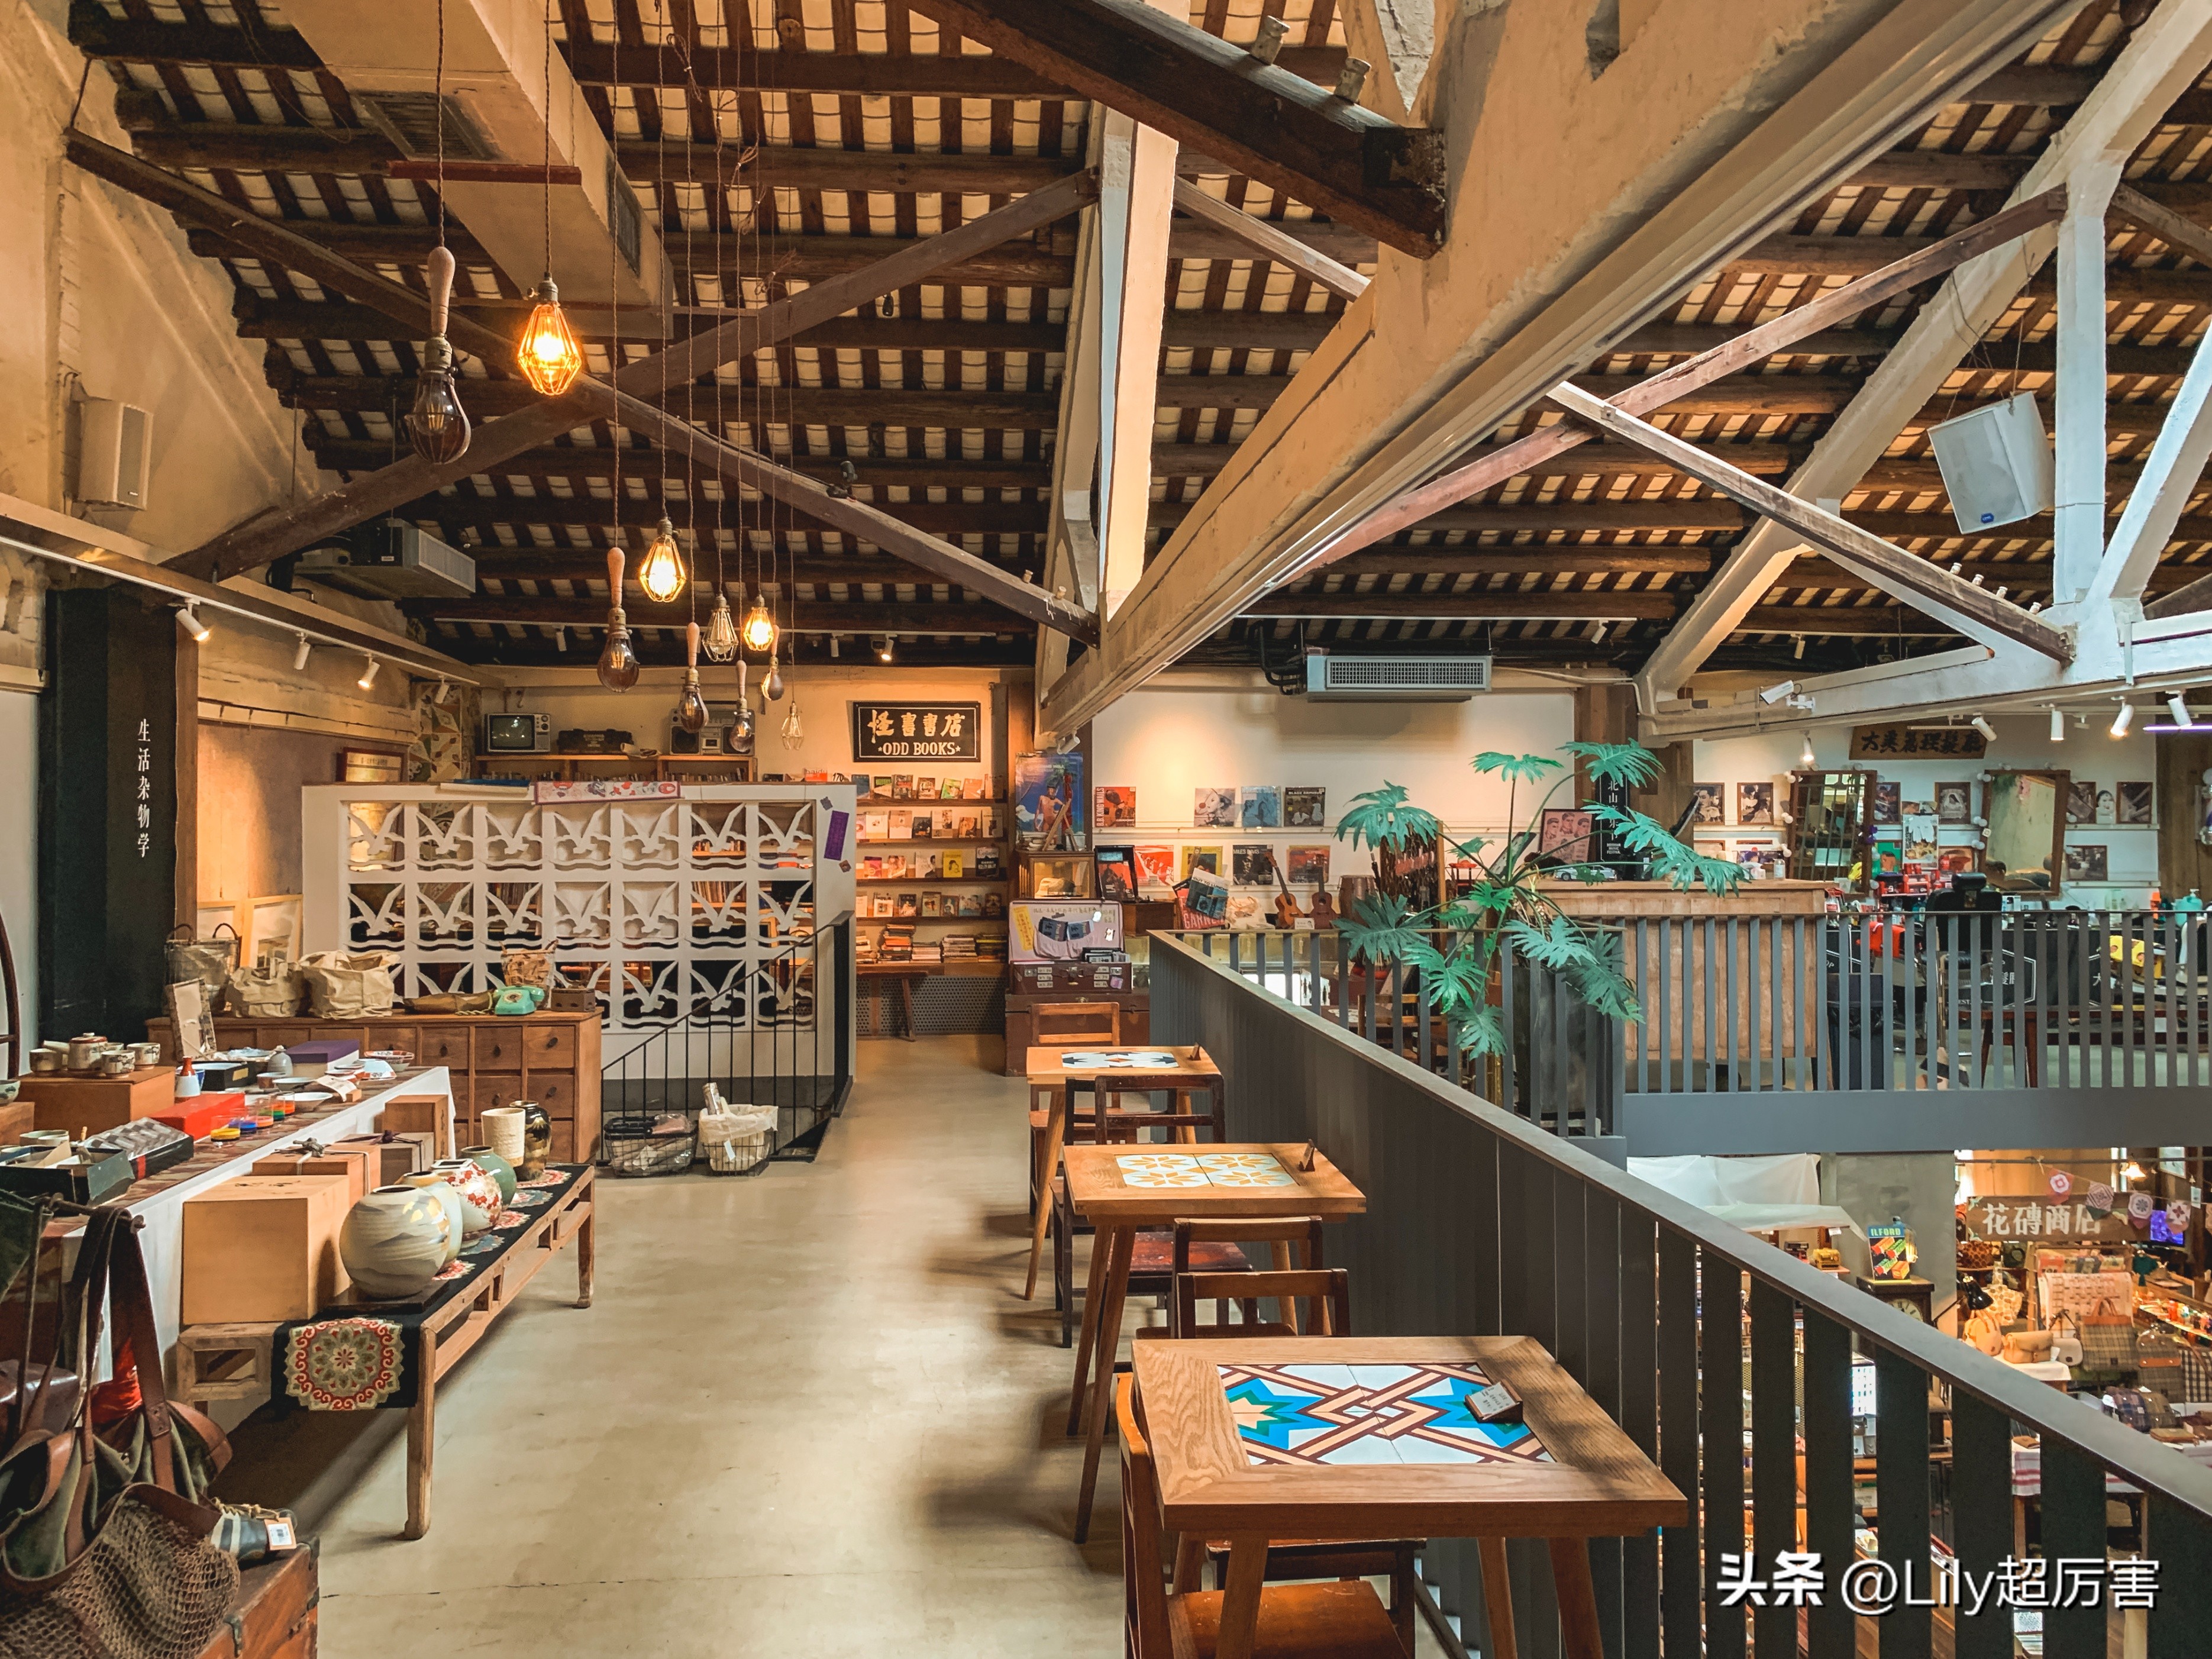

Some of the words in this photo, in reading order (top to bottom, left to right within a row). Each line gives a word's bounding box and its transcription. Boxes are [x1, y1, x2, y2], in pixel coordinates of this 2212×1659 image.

[867, 709, 965, 744] 怪書書店
[883, 743, 909, 756] ODD
[913, 742, 956, 756] BOOKS
[137, 718, 151, 858] 生活杂物学
[1871, 1228, 1901, 1237] ILFORD
[1982, 1202, 2101, 1235] 花磚商店
